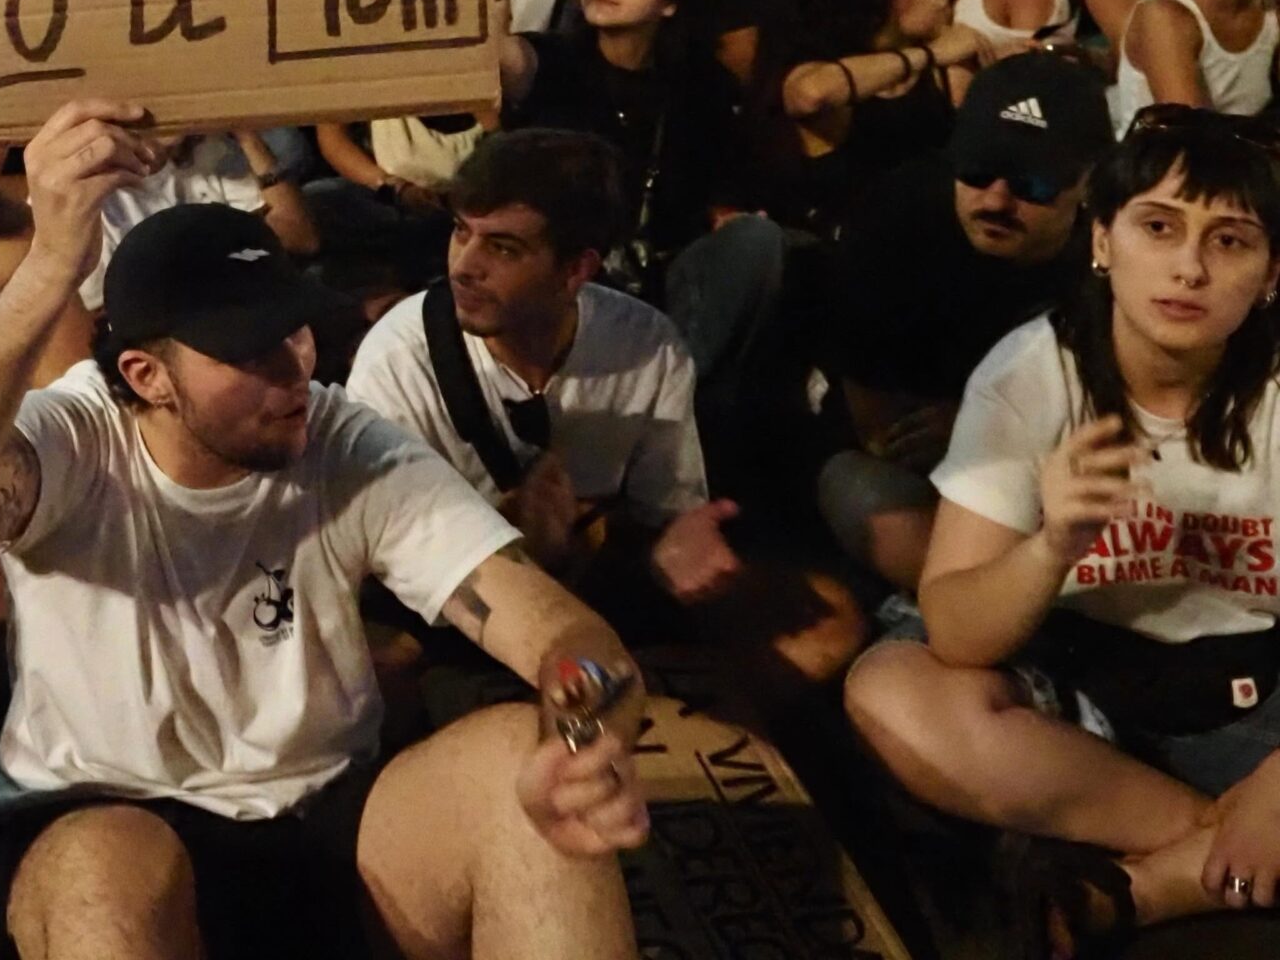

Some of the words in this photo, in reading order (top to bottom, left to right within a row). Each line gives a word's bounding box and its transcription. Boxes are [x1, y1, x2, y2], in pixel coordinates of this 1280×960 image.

[1145, 502, 1174, 525] IN
[1182, 512, 1274, 537] DOUBT
[1087, 521, 1276, 573] ALWAYS
[1077, 556, 1163, 586] BLAME
[1170, 558, 1191, 578] A
